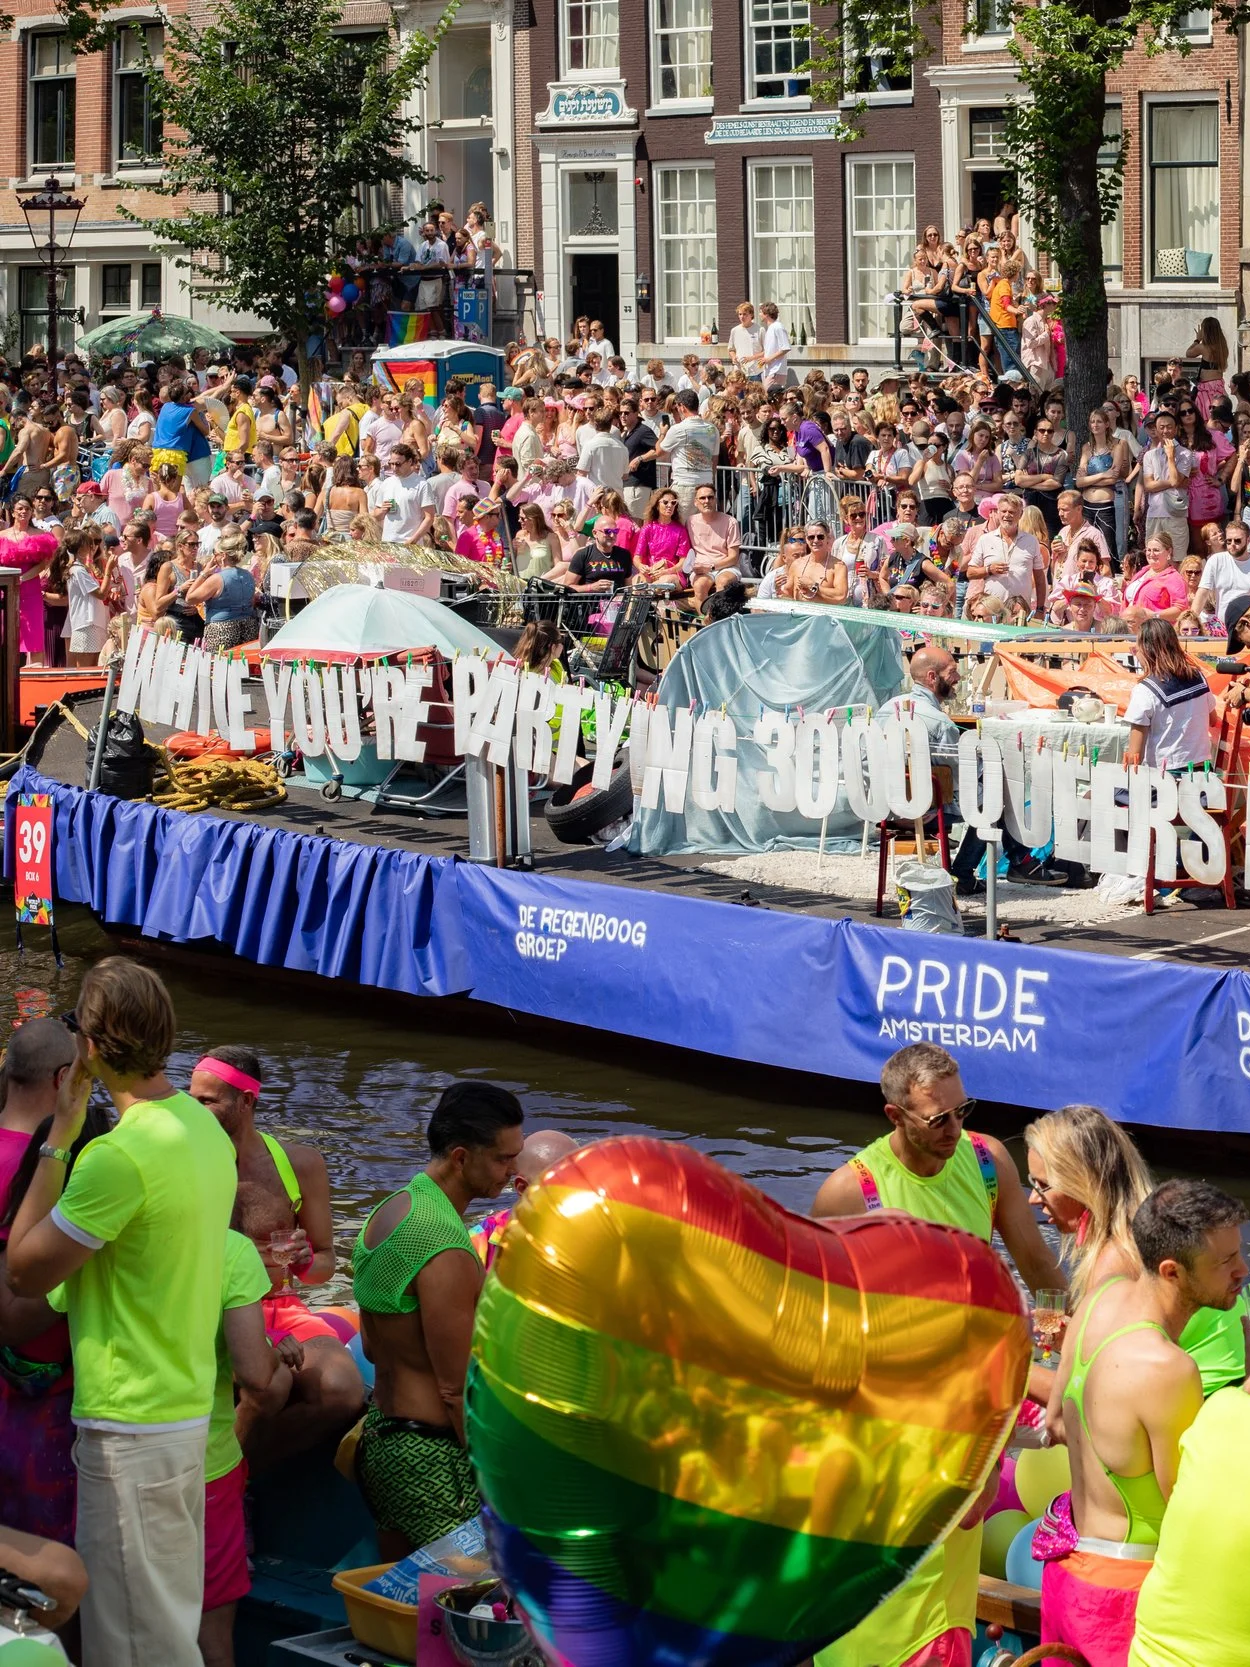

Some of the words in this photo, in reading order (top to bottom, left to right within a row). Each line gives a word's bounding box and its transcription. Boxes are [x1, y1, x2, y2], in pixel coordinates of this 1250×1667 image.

[464, 302, 470, 320] P
[19, 820, 46, 864] 39
[25, 871, 35, 881] BOX
[36, 872, 39, 882] 6
[518, 904, 538, 928] DE
[540, 907, 647, 949] REGENBOOG
[516, 931, 567, 962] GROEP
[876, 966, 1049, 1026] PRIDE
[878, 1018, 1037, 1053] AMSTERDAM
